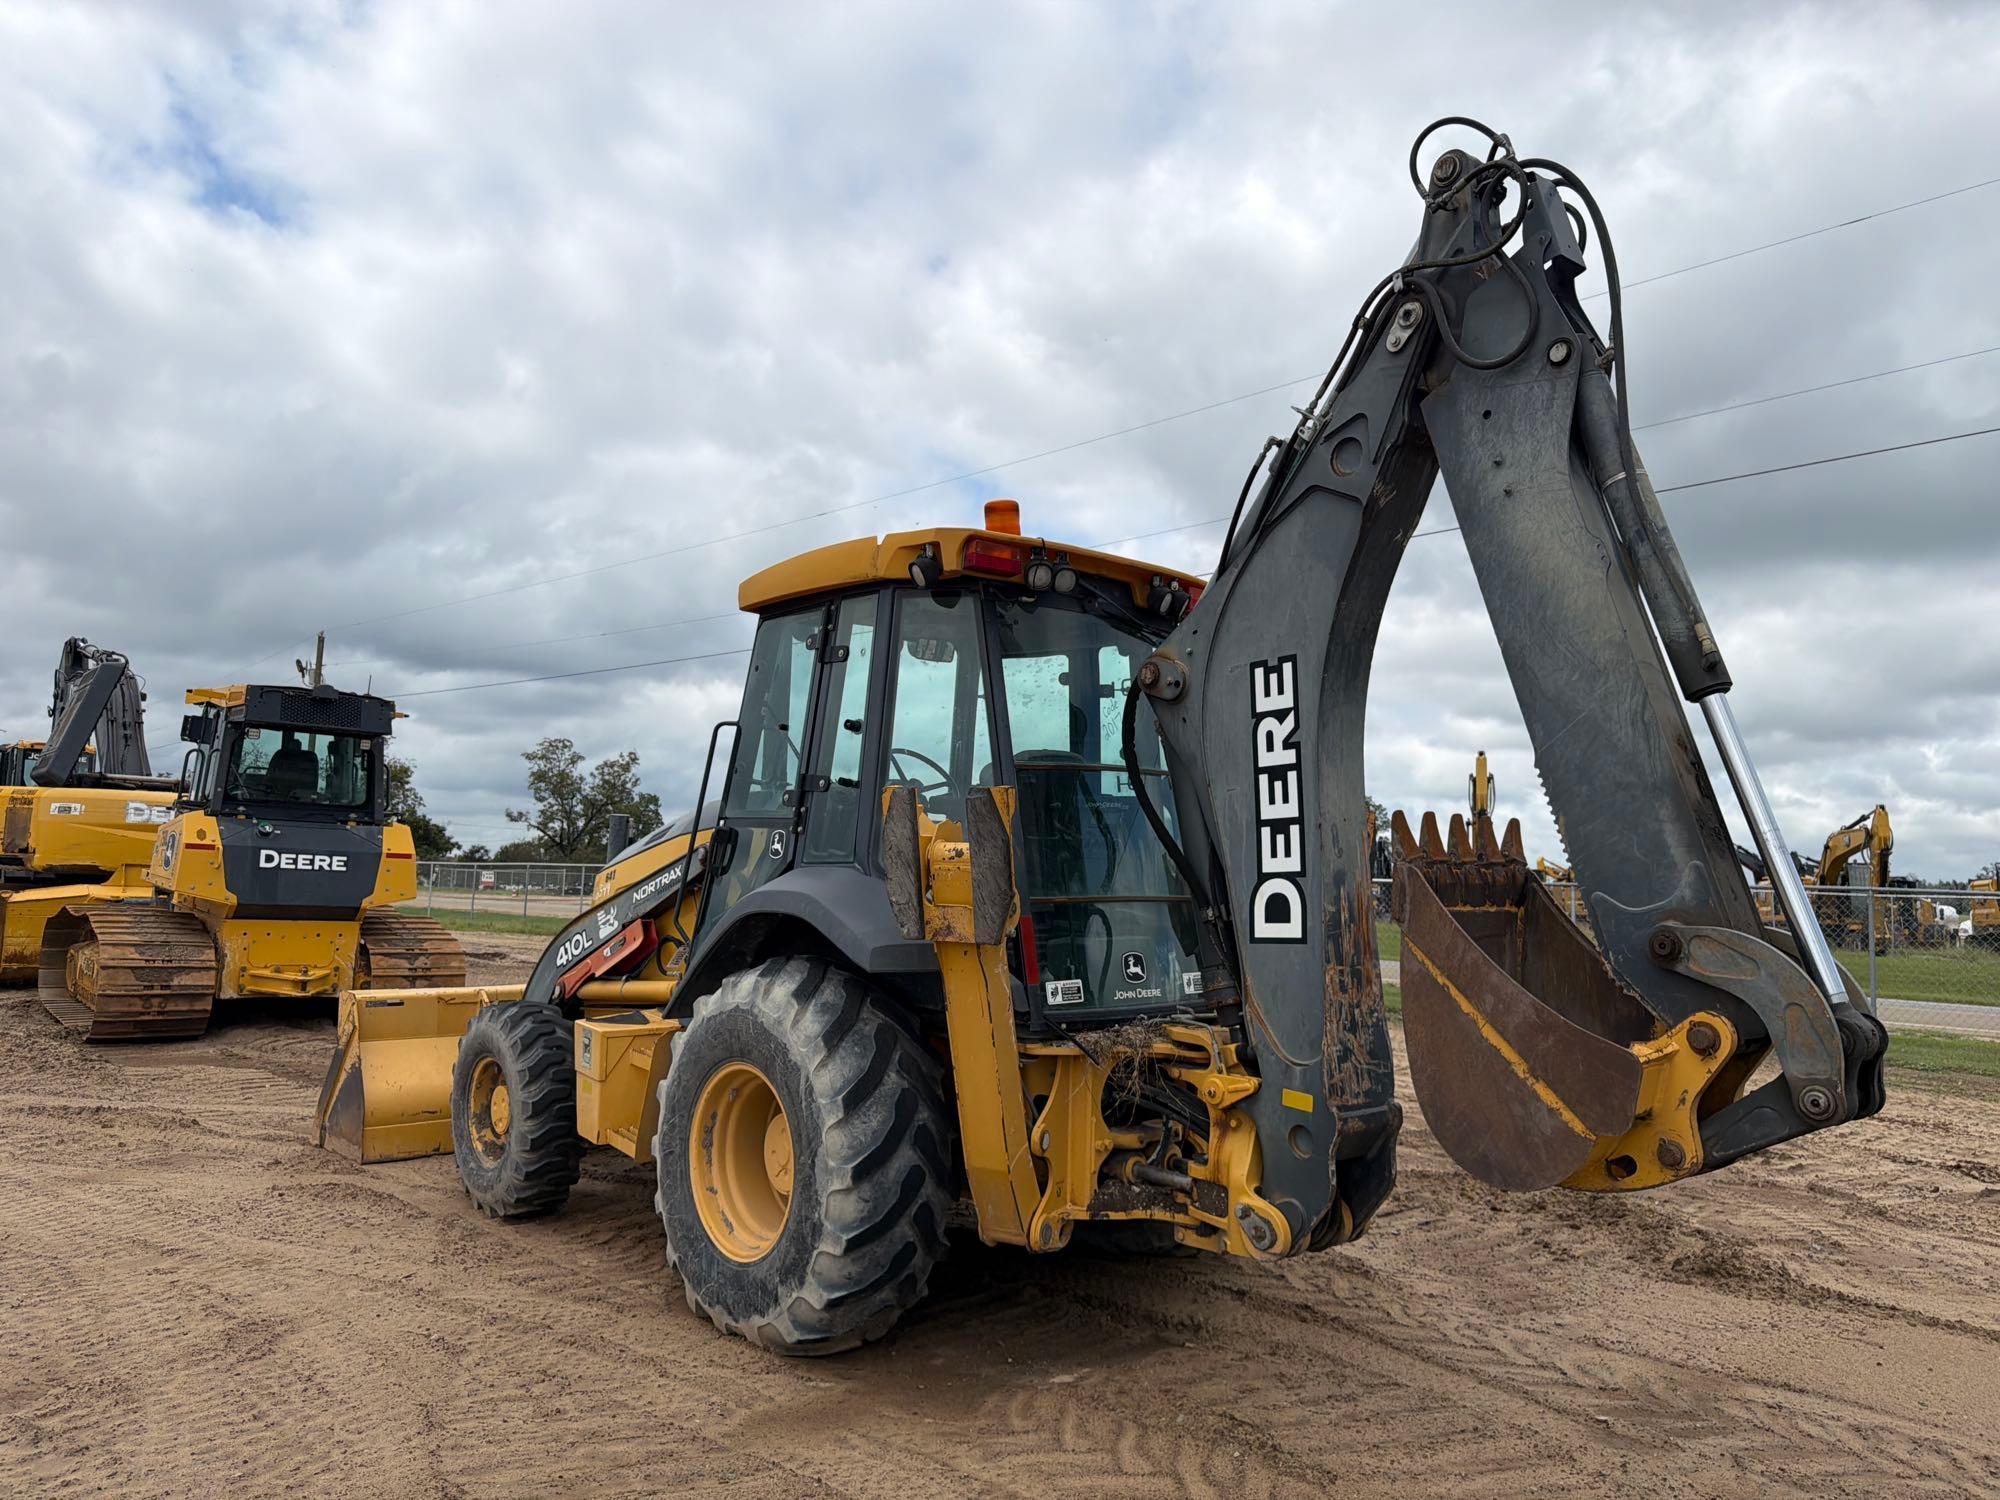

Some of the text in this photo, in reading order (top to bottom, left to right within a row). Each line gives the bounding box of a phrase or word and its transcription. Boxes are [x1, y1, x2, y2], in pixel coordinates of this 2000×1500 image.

[1252, 659, 1304, 940] DEERE
[259, 849, 348, 871] DEERE
[632, 865, 682, 904] NORTRAX
[556, 930, 593, 968] 410L
[1113, 988, 1162, 1000] JOHN DEERE
